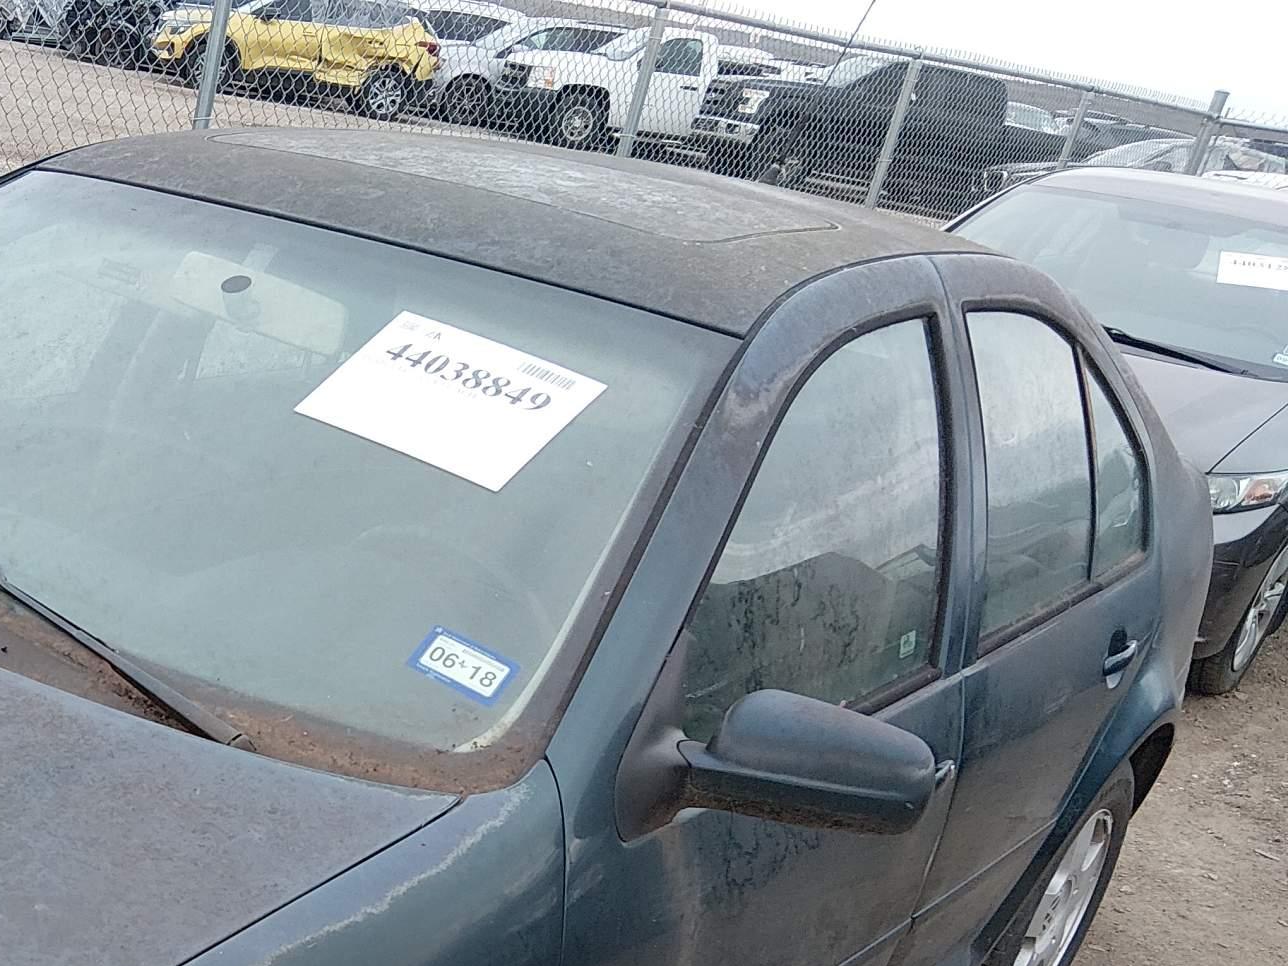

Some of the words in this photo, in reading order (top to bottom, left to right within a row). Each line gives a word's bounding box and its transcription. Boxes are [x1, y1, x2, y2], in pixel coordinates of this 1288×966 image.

[386, 343, 553, 411] 44038849
[428, 646, 460, 669] 06
[469, 665, 497, 688] 18
